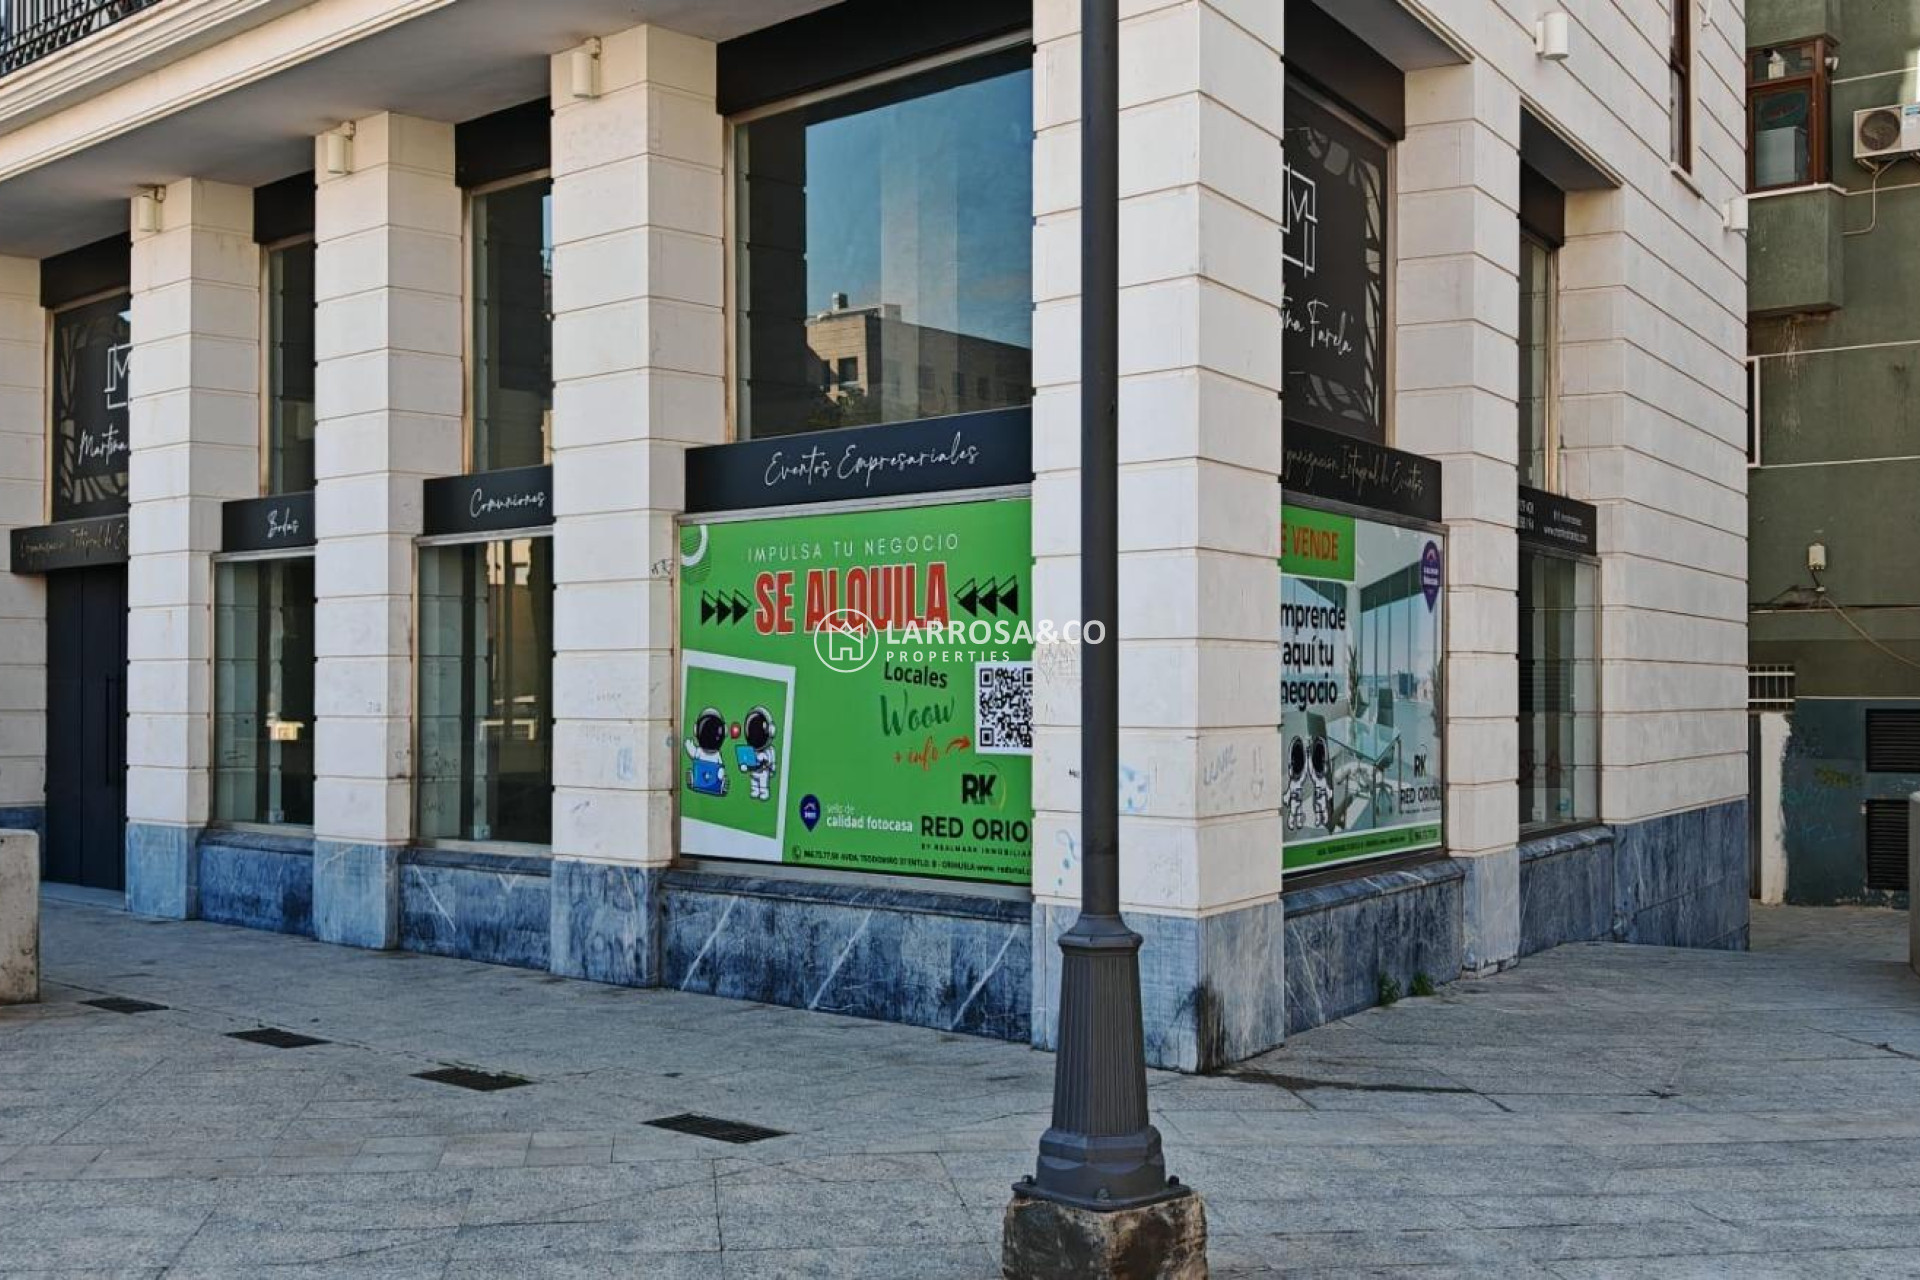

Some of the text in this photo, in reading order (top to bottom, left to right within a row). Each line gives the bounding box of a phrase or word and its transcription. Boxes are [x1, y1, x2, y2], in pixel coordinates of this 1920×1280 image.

[764, 431, 979, 487] Eventos Empresariales
[470, 488, 545, 518] Comuniones
[267, 507, 299, 540] Bodas
[748, 534, 959, 562] IMPULSA TU NEGOCIO
[1293, 527, 1340, 561] VENDE
[754, 562, 950, 638] SE ALQUILA
[1283, 635, 1334, 674] aquí tu
[884, 662, 948, 689] Locales
[1281, 673, 1338, 711] negocio
[909, 736, 940, 771] info
[962, 773, 997, 804] RK
[827, 815, 913, 832] calidad fotocasa
[921, 815, 964, 838] RED
